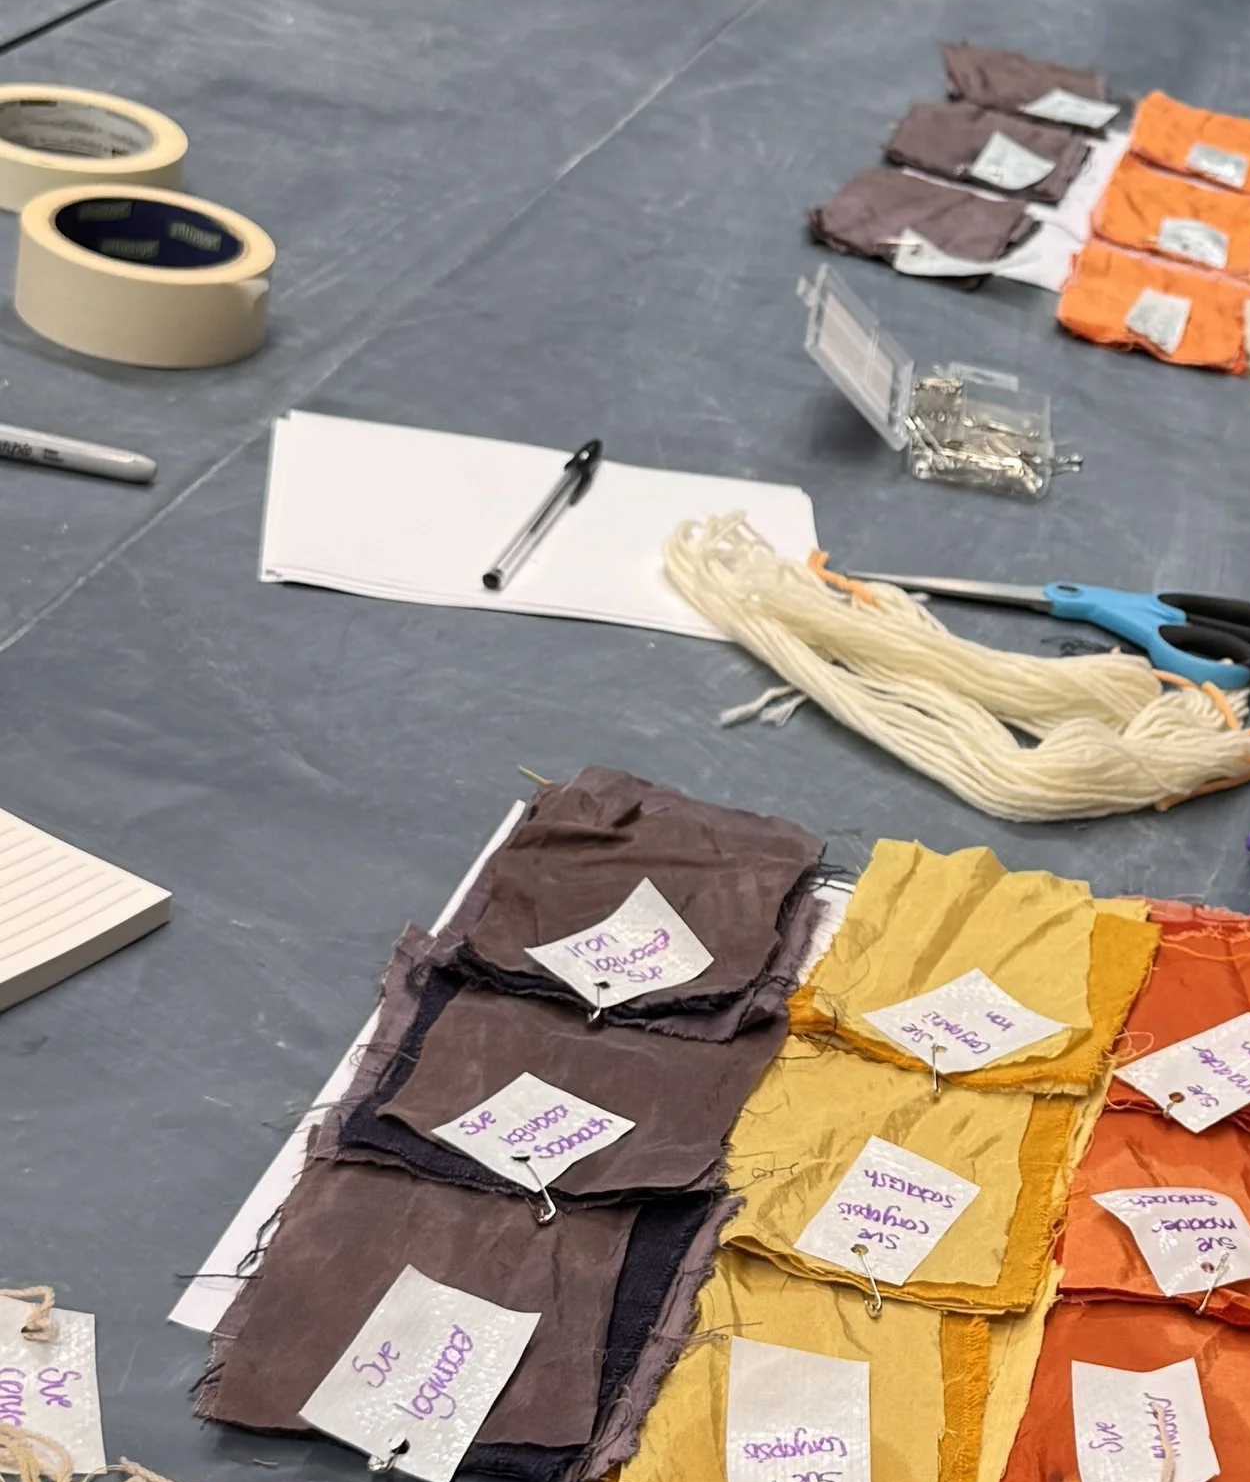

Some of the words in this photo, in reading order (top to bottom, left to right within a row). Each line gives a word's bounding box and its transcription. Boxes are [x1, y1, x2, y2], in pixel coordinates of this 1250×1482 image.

[564, 932, 619, 959] Iron
[626, 965, 663, 983] Sue
[901, 1022, 933, 1044] Sue
[1187, 1084, 1219, 1109] Sue
[459, 1110, 497, 1136] Sue
[857, 1228, 900, 1250] Sue
[1195, 1236, 1237, 1253] Sue
[352, 1340, 400, 1389] Sue
[37, 1367, 82, 1408] Sue
[1088, 1421, 1125, 1453] Sue
